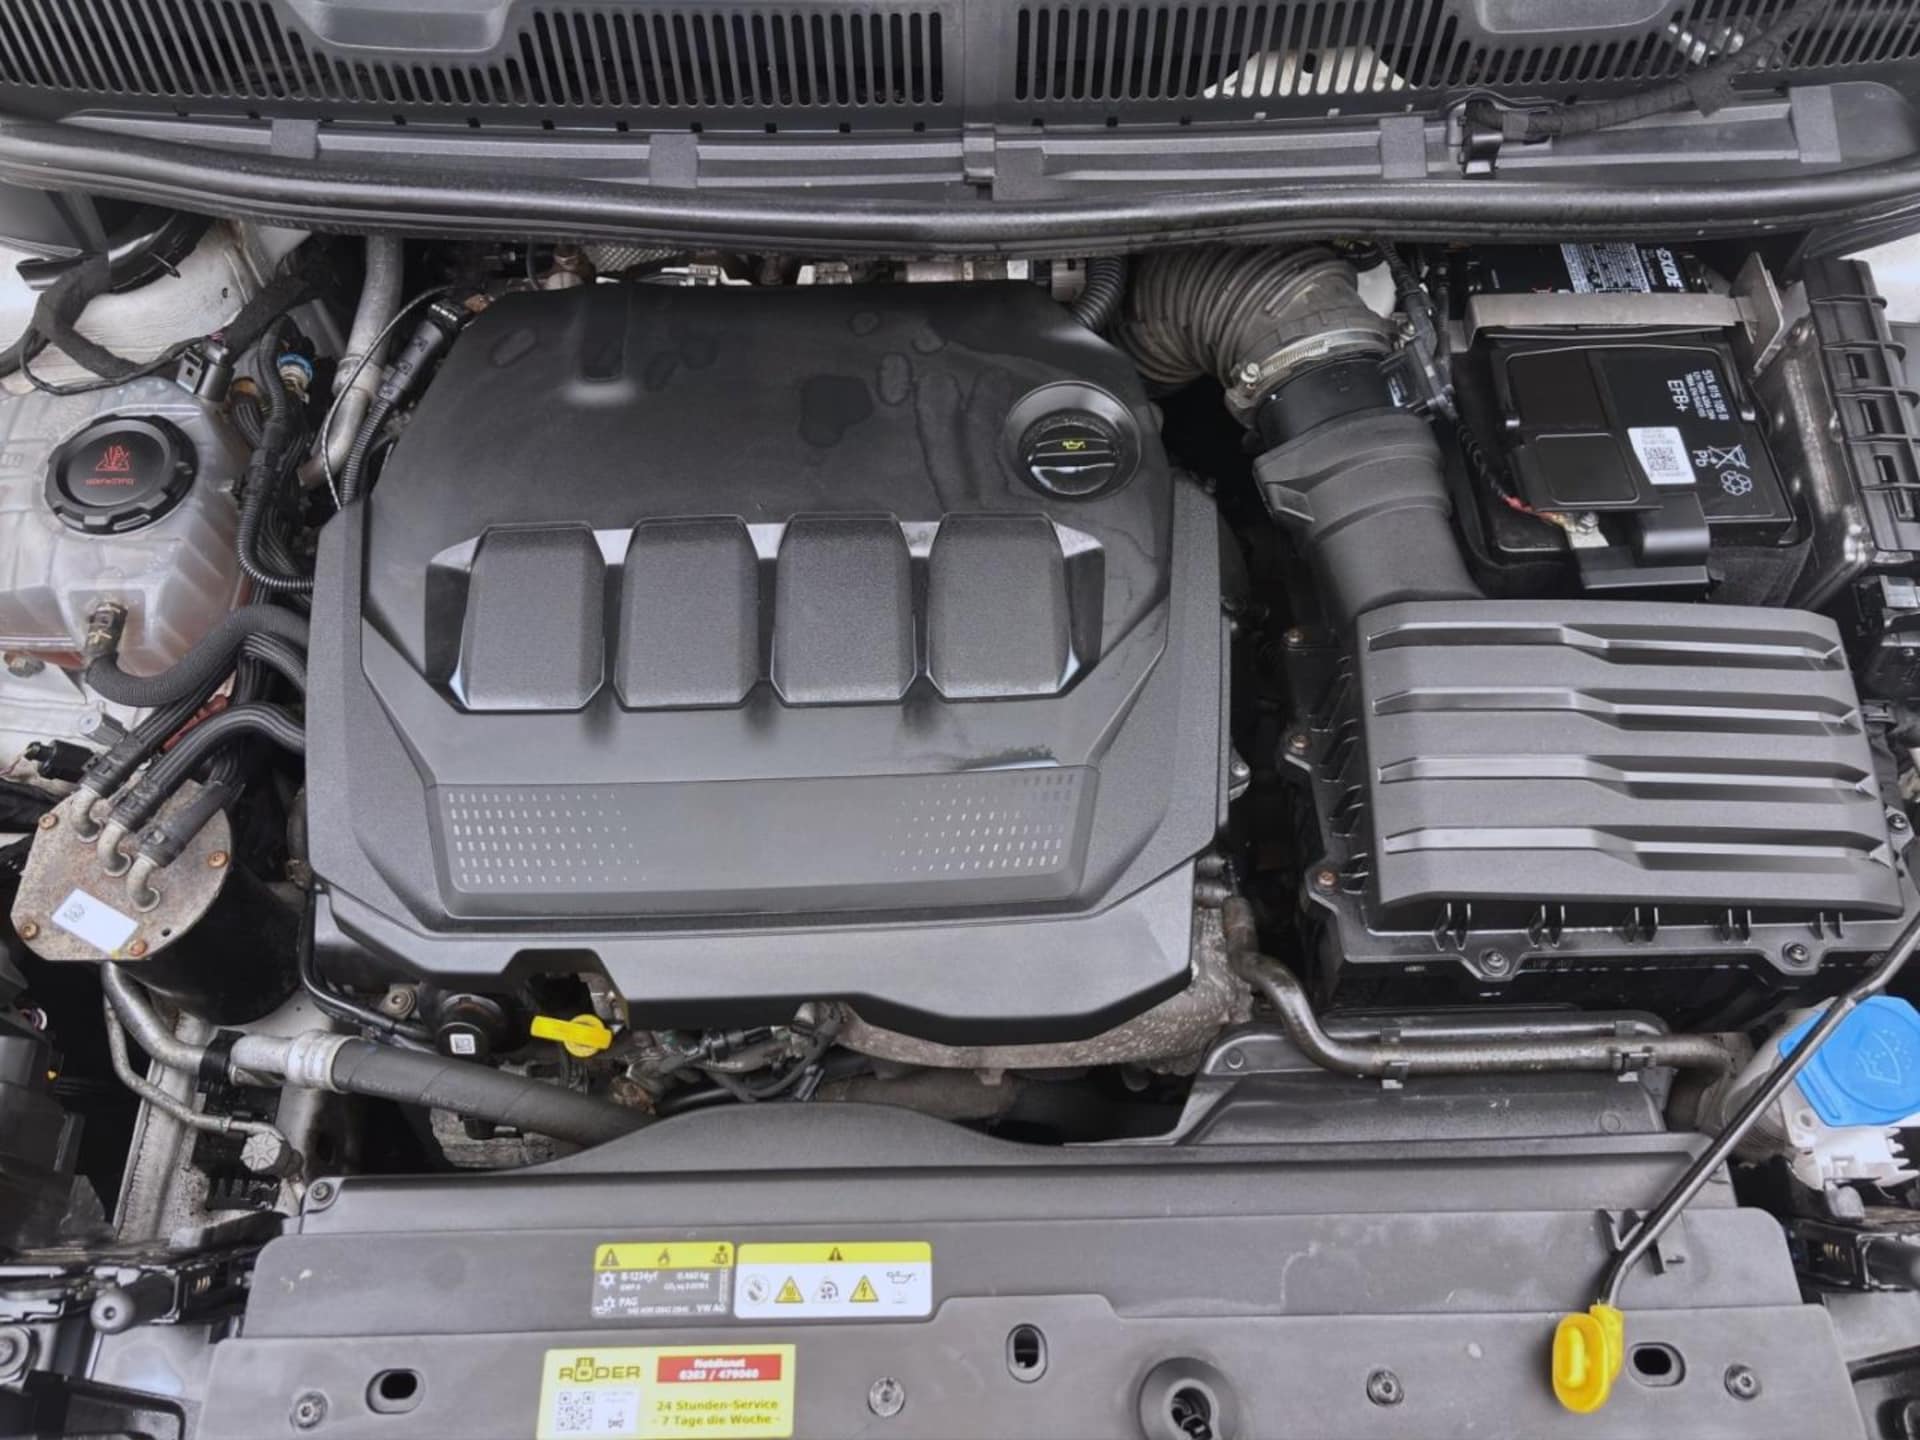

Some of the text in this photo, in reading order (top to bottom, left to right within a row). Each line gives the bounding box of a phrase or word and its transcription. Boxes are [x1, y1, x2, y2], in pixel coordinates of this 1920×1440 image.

[1656, 247, 1683, 288] EXIDE
[1667, 379, 1689, 412] EFB+
[1692, 450, 1709, 467] Pb
[618, 1297, 638, 1308] PAG
[695, 1304, 712, 1313] VW
[656, 1399, 779, 1412] 24 Stunden-Service
[661, 1416, 670, 1426] 7
[674, 1415, 705, 1427] Tage
[706, 1415, 726, 1425] die
[729, 1414, 773, 1425] Woche
